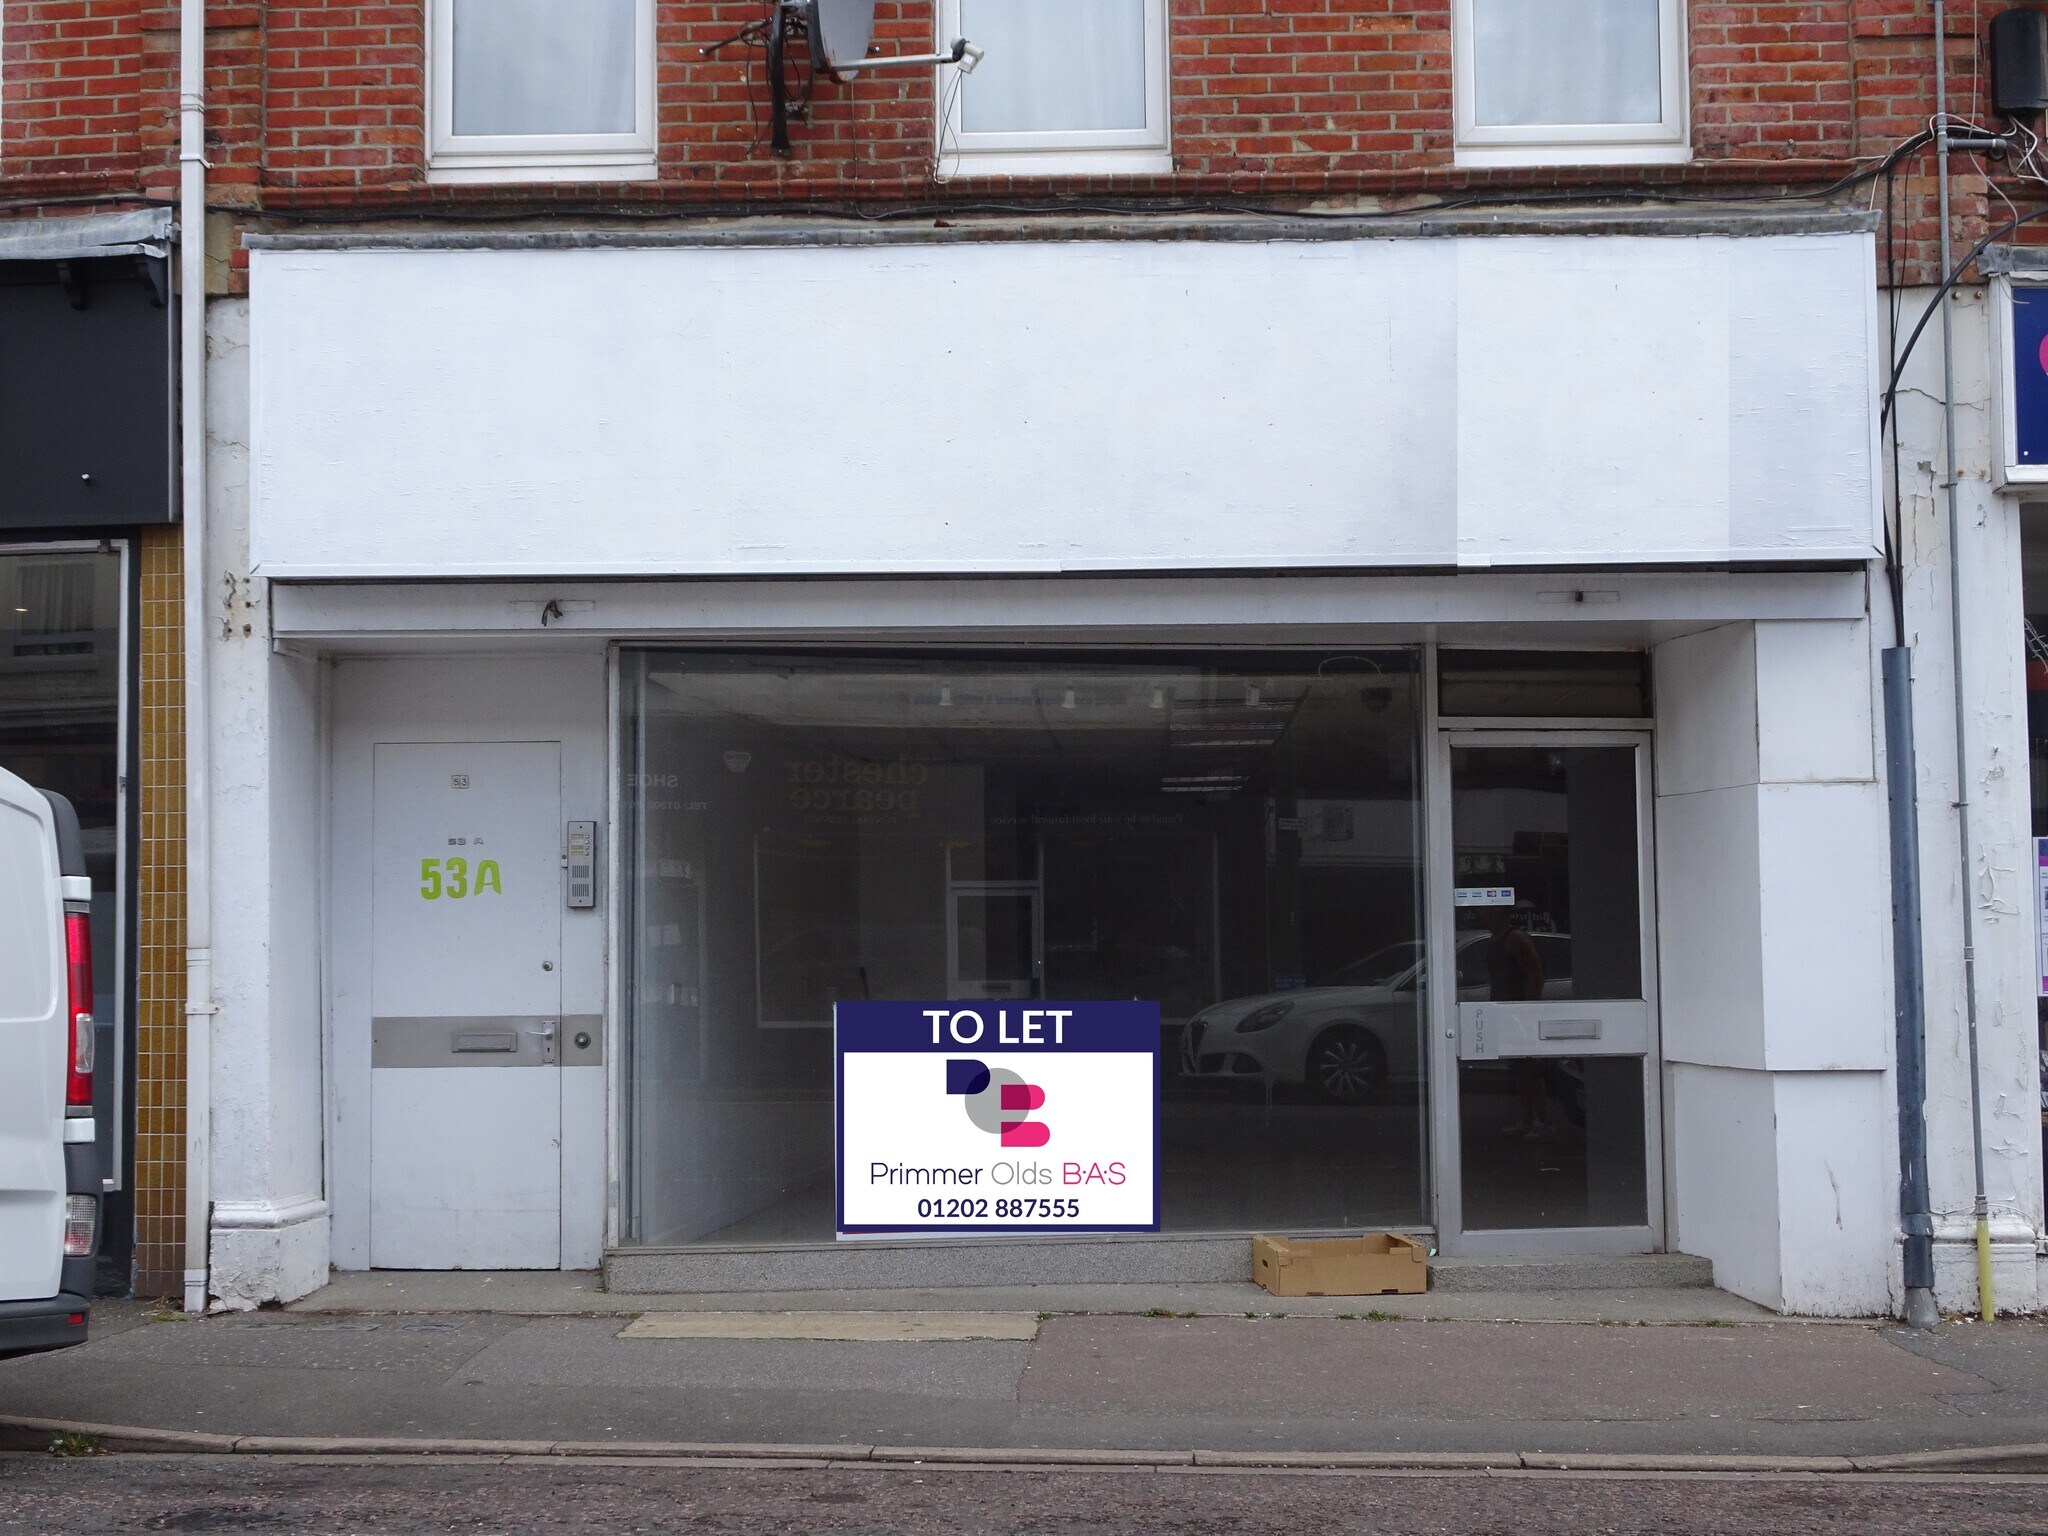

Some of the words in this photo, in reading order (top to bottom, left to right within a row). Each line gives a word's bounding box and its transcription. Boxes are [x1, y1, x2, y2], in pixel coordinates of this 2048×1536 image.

[453, 777, 468, 787] 53
[448, 838, 466, 846] 53
[473, 837, 484, 845] A
[421, 857, 502, 900] 53A
[922, 1009, 985, 1044] TO
[999, 1010, 1073, 1044] LET
[1475, 1008, 1484, 1054] PUSH
[870, 1162, 984, 1185] Primmer
[991, 1161, 1053, 1186] Olds
[917, 1198, 989, 1218] 01202
[995, 1198, 1080, 1218] 887555
